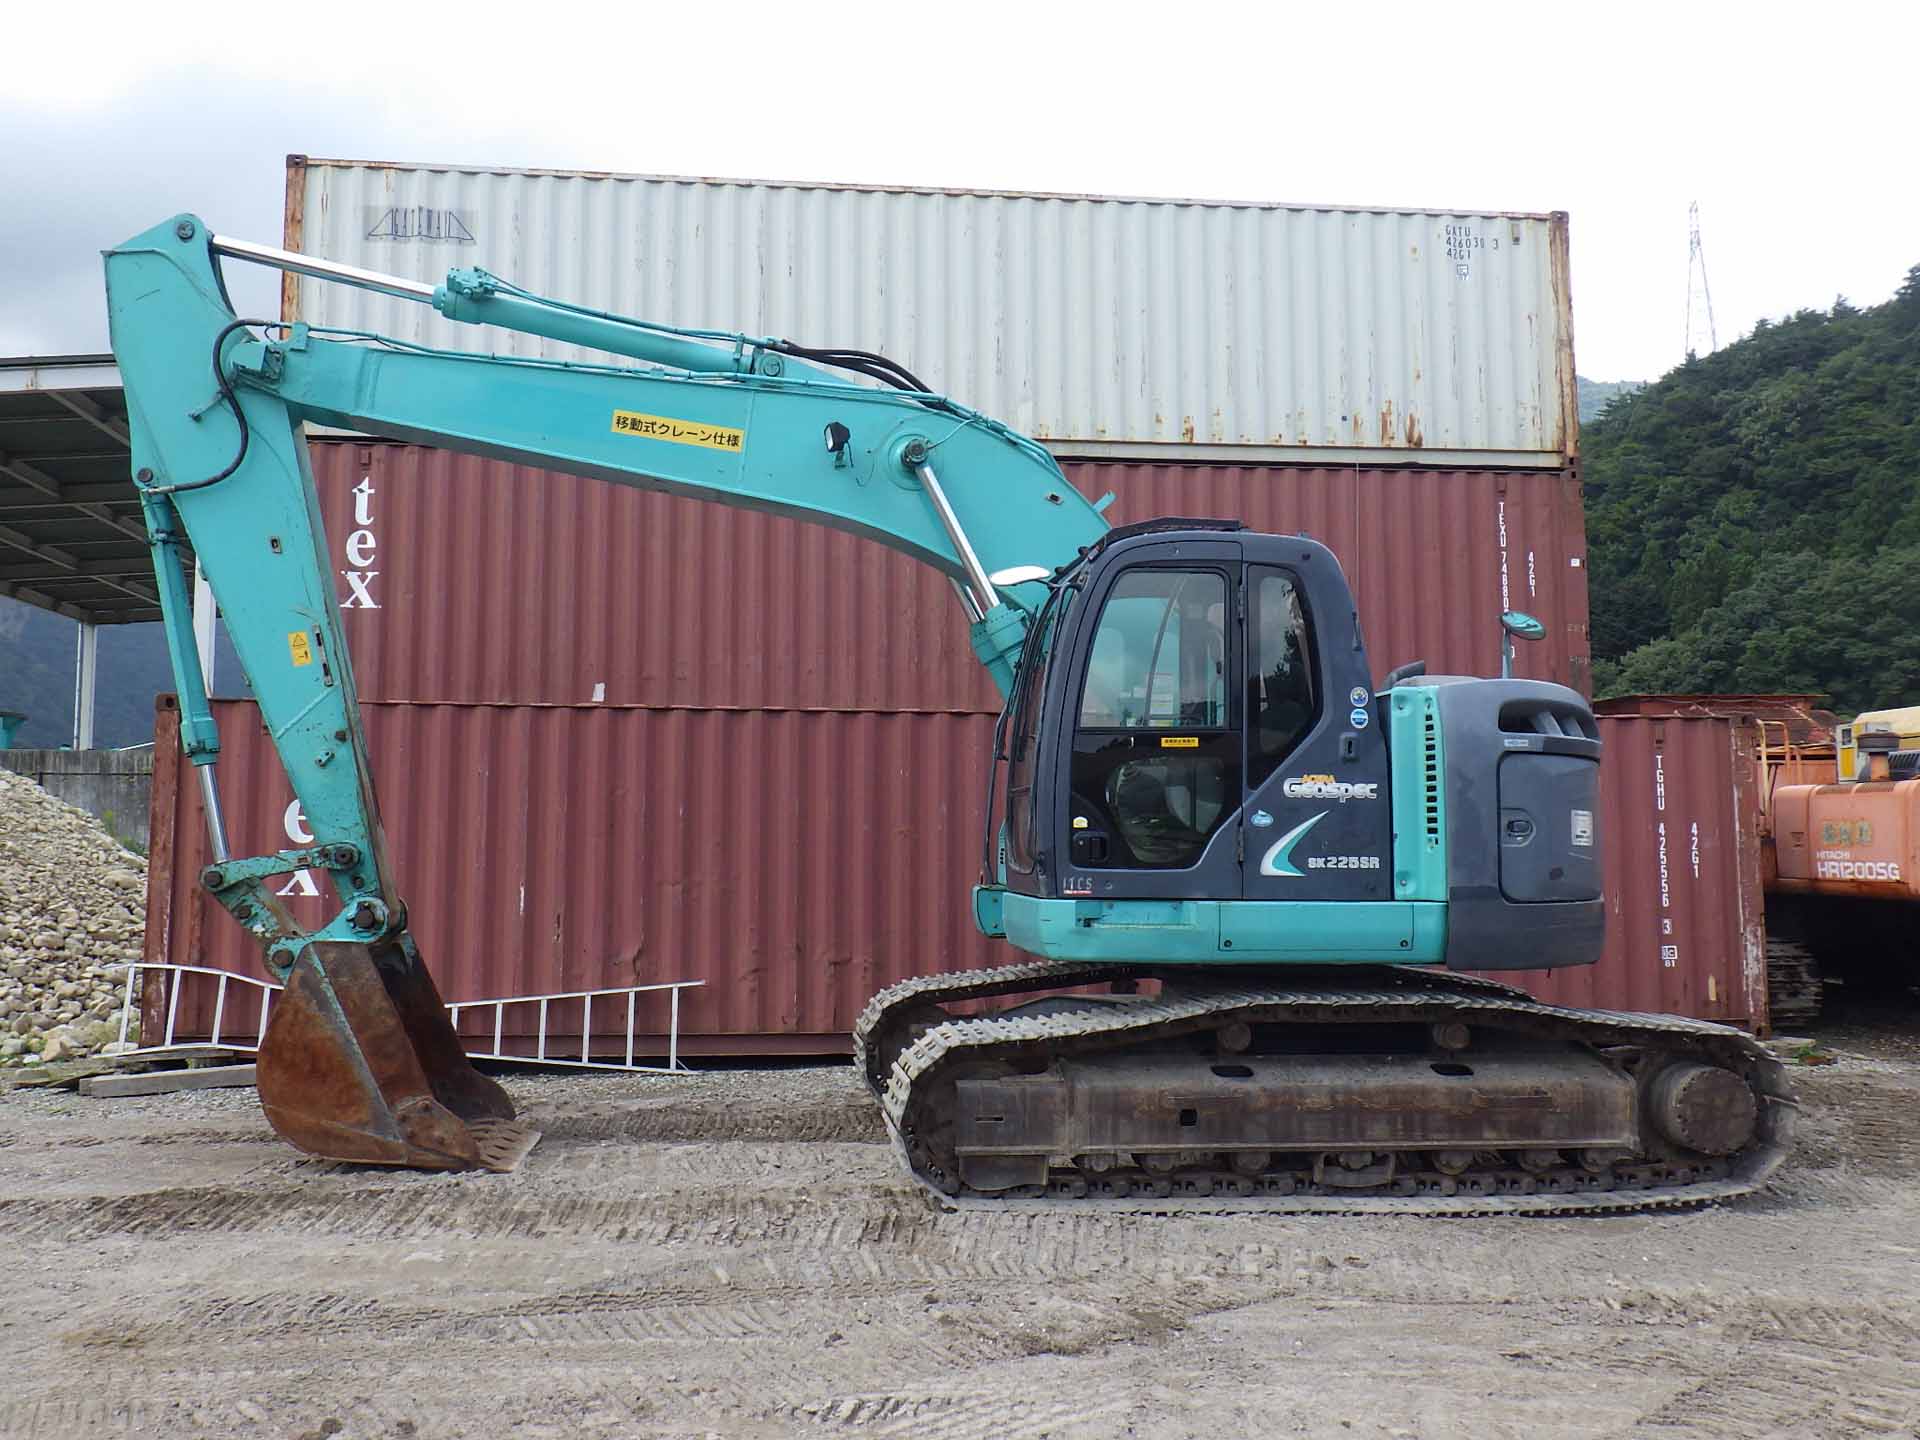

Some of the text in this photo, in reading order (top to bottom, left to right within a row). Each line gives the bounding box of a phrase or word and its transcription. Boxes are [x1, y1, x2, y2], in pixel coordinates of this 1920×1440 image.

[1446, 247, 1471, 260] 42G1
[1492, 238, 1499, 250] 3
[615, 415, 740, 447] 移動式クレーン仕様
[339, 476, 383, 609] tex
[1498, 502, 1509, 613] TEXU 74880
[1528, 551, 1536, 598] 42G1
[1283, 777, 1378, 803] Geospec
[275, 799, 320, 896] ex
[1655, 755, 1672, 935] TGHU 425556 3
[1691, 822, 1699, 879] 42G1
